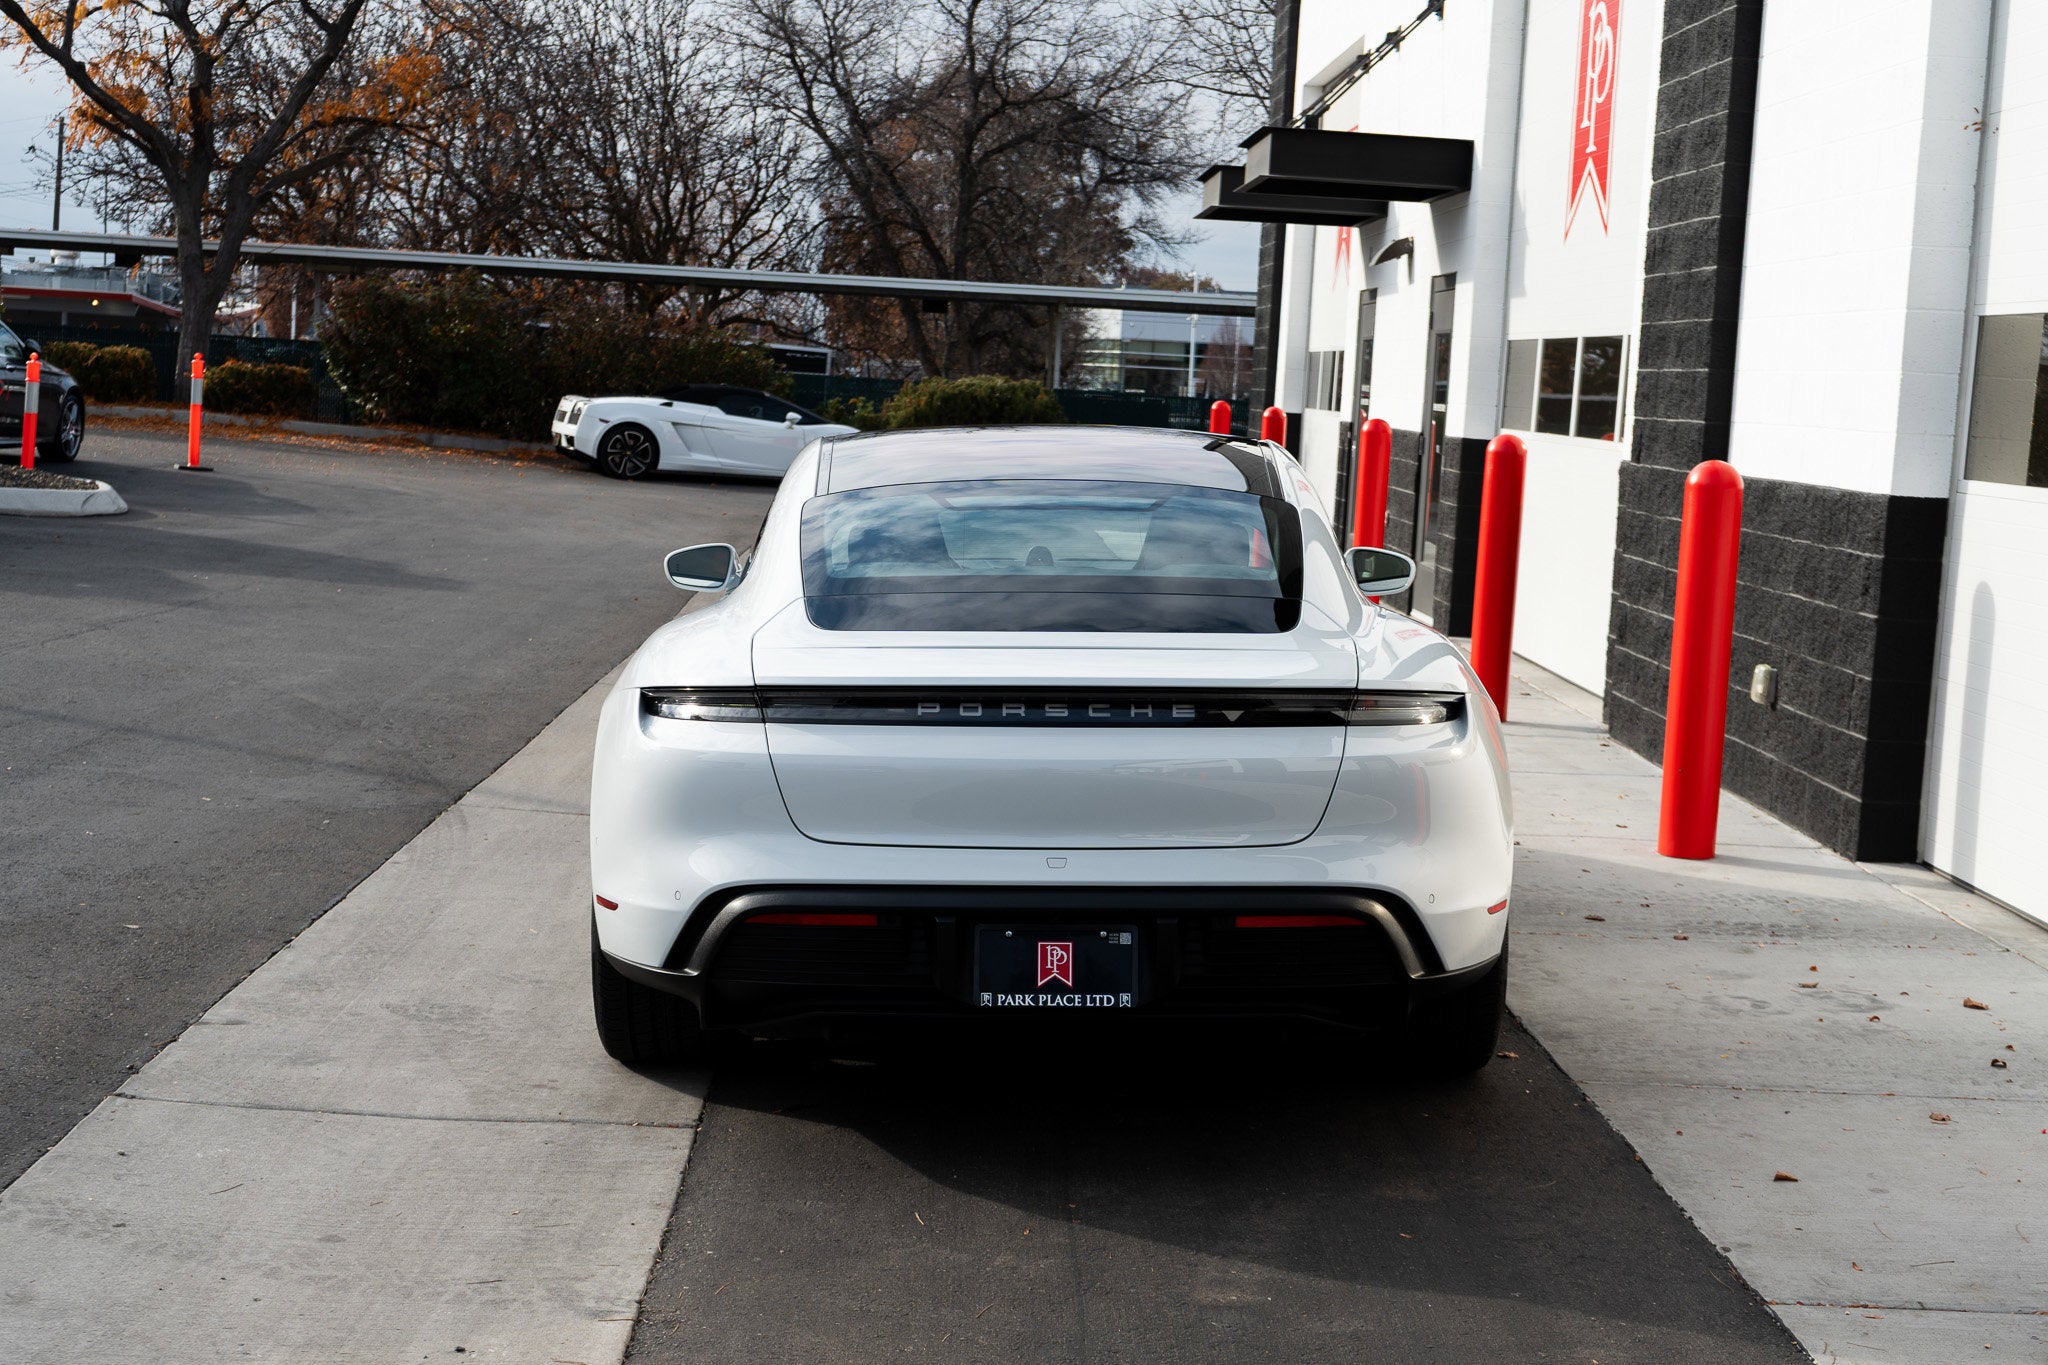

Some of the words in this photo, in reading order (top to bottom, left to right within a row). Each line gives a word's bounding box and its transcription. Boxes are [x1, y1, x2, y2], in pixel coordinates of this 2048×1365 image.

[917, 702, 1195, 718] PORSCHE
[997, 994, 1035, 1006] PARK
[1038, 994, 1082, 1007] PLACE
[1086, 995, 1115, 1007] LTD
